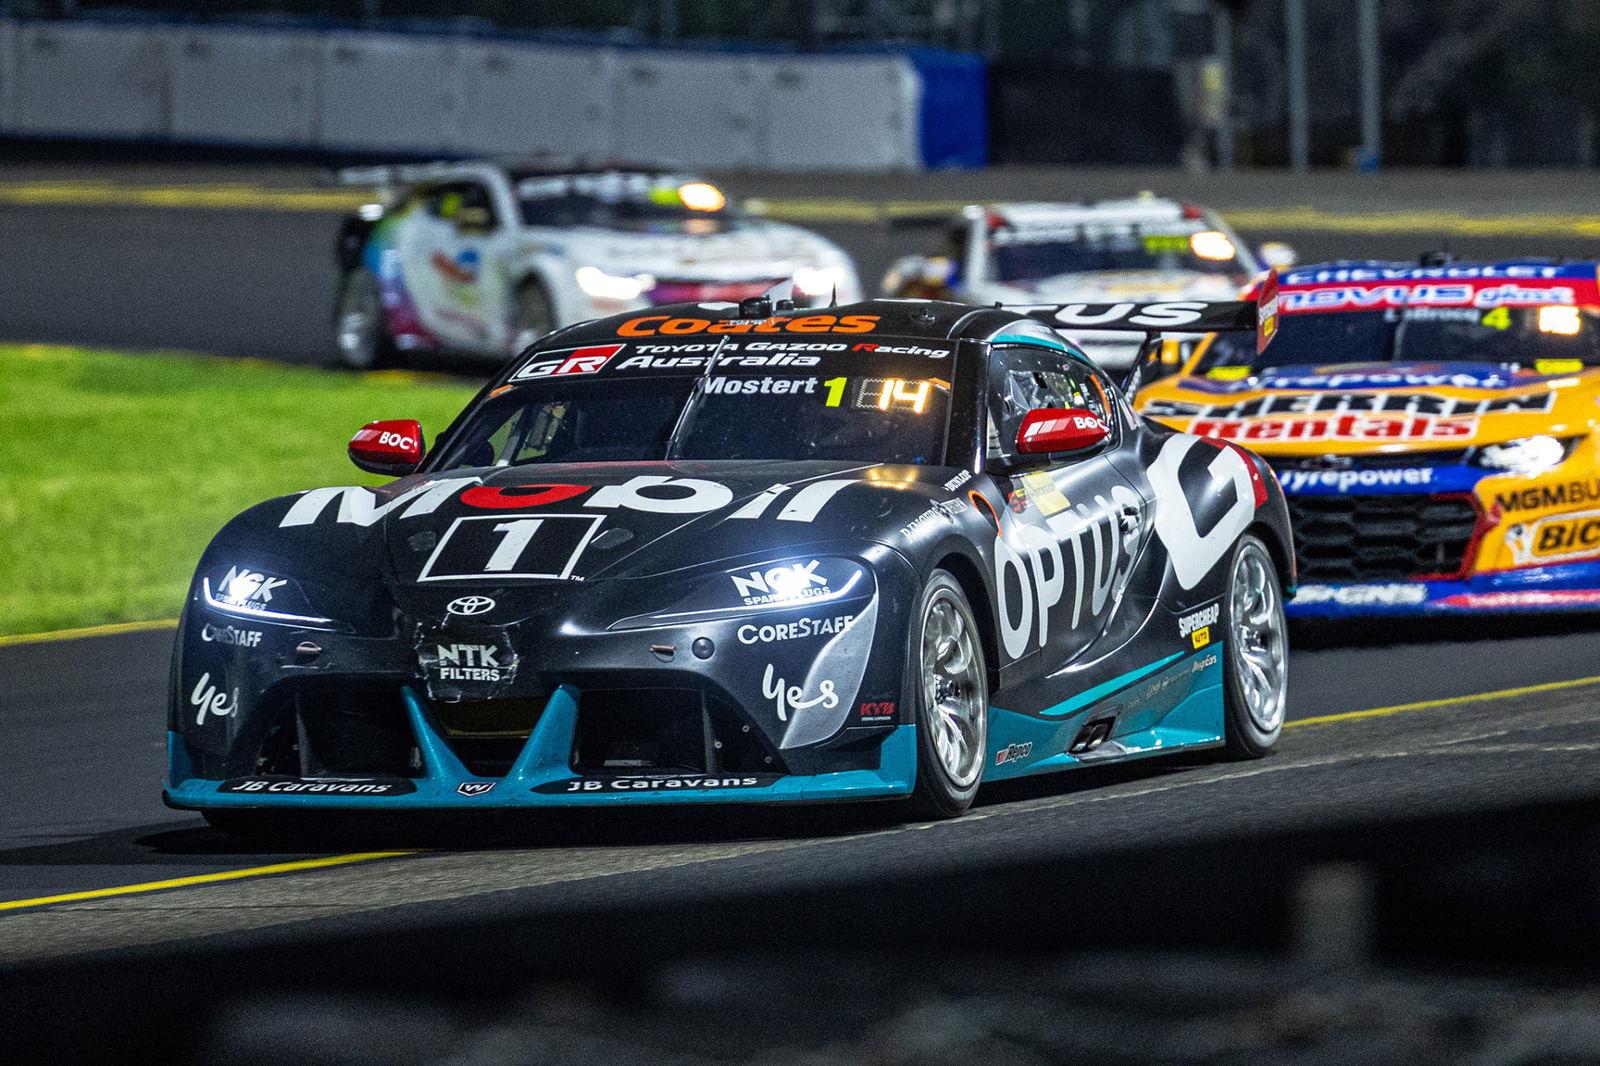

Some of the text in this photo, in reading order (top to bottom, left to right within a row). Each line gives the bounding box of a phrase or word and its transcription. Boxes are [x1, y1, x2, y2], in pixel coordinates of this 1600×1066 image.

[616, 315, 881, 336] Coates
[1482, 306, 1511, 331] 4
[615, 353, 821, 369] Australia
[852, 343, 950, 358] Racing
[517, 356, 607, 378] GR
[703, 377, 848, 407] Mostert 1
[879, 379, 930, 413] 14
[1073, 416, 1110, 432] BOC
[379, 431, 413, 450] BOC
[279, 475, 863, 528] Mobil
[483, 518, 545, 572] 1
[437, 644, 500, 667] NTK
[440, 667, 500, 682] FILTERS
[232, 780, 393, 793] JB Caravans
[568, 777, 758, 792] JB Caravans
